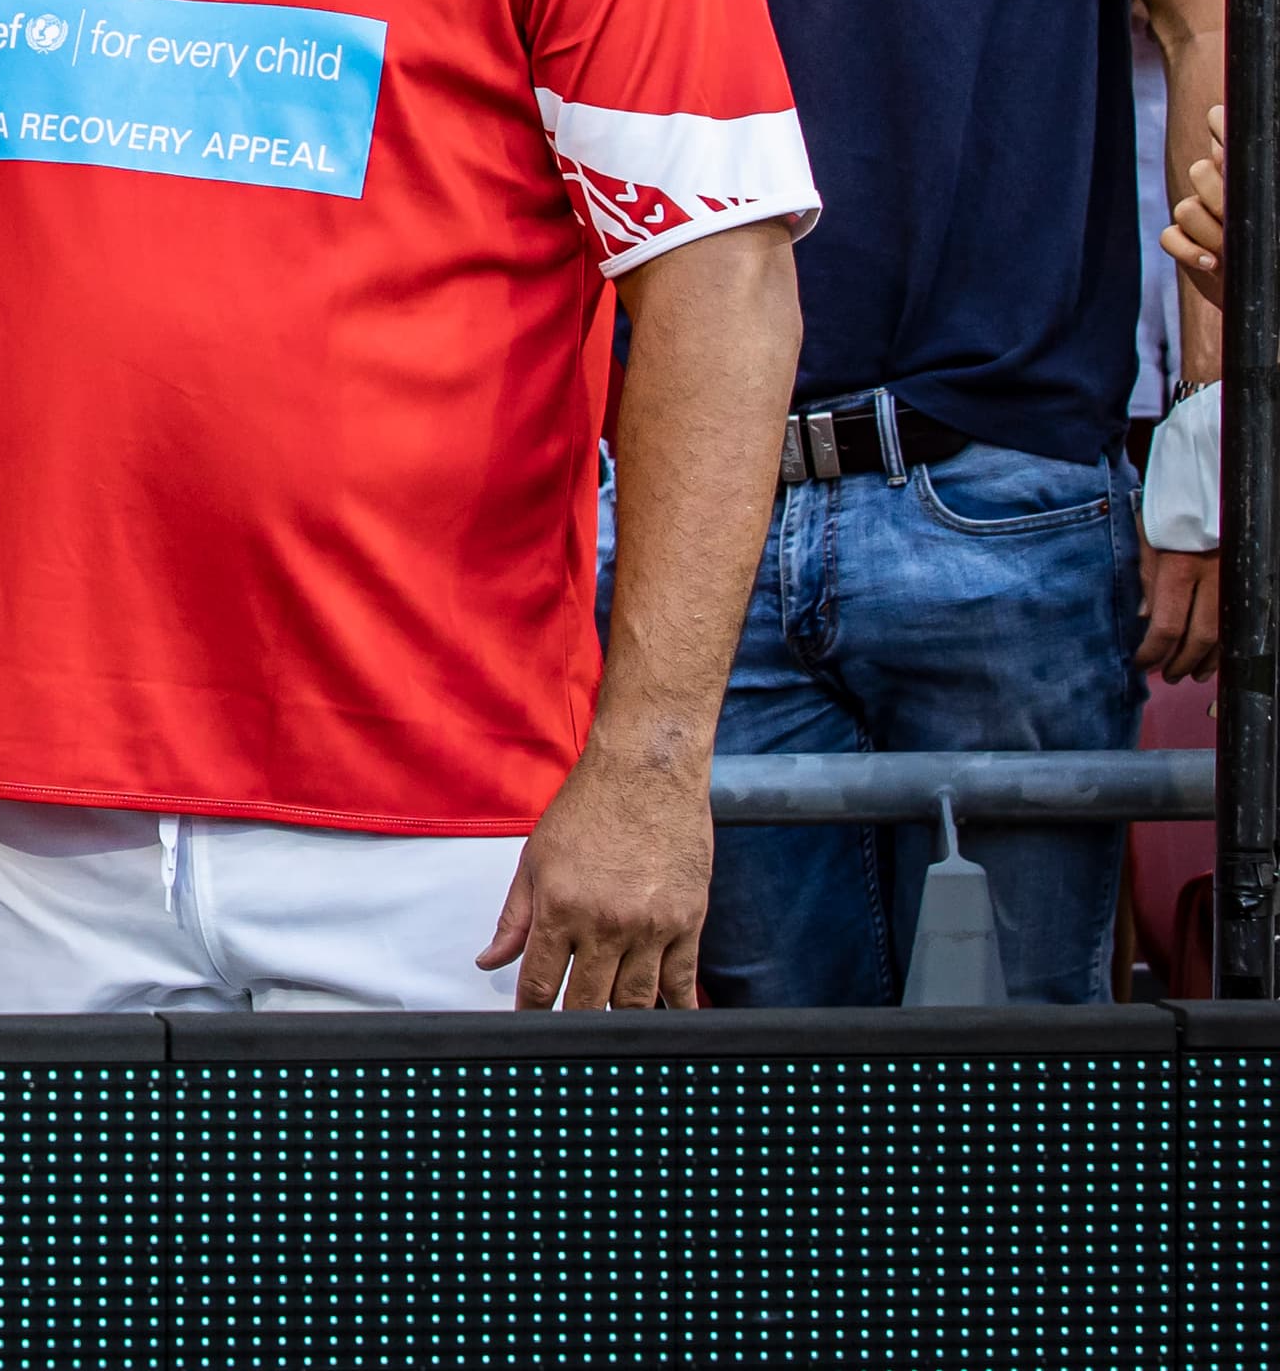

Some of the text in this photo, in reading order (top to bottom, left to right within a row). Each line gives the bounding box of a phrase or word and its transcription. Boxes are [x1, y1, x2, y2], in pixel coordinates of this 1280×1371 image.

[91, 19, 140, 58] for
[147, 36, 249, 79] every
[255, 38, 342, 81] child
[20, 112, 192, 155] RECOVERY
[202, 131, 335, 173] APPEAL
